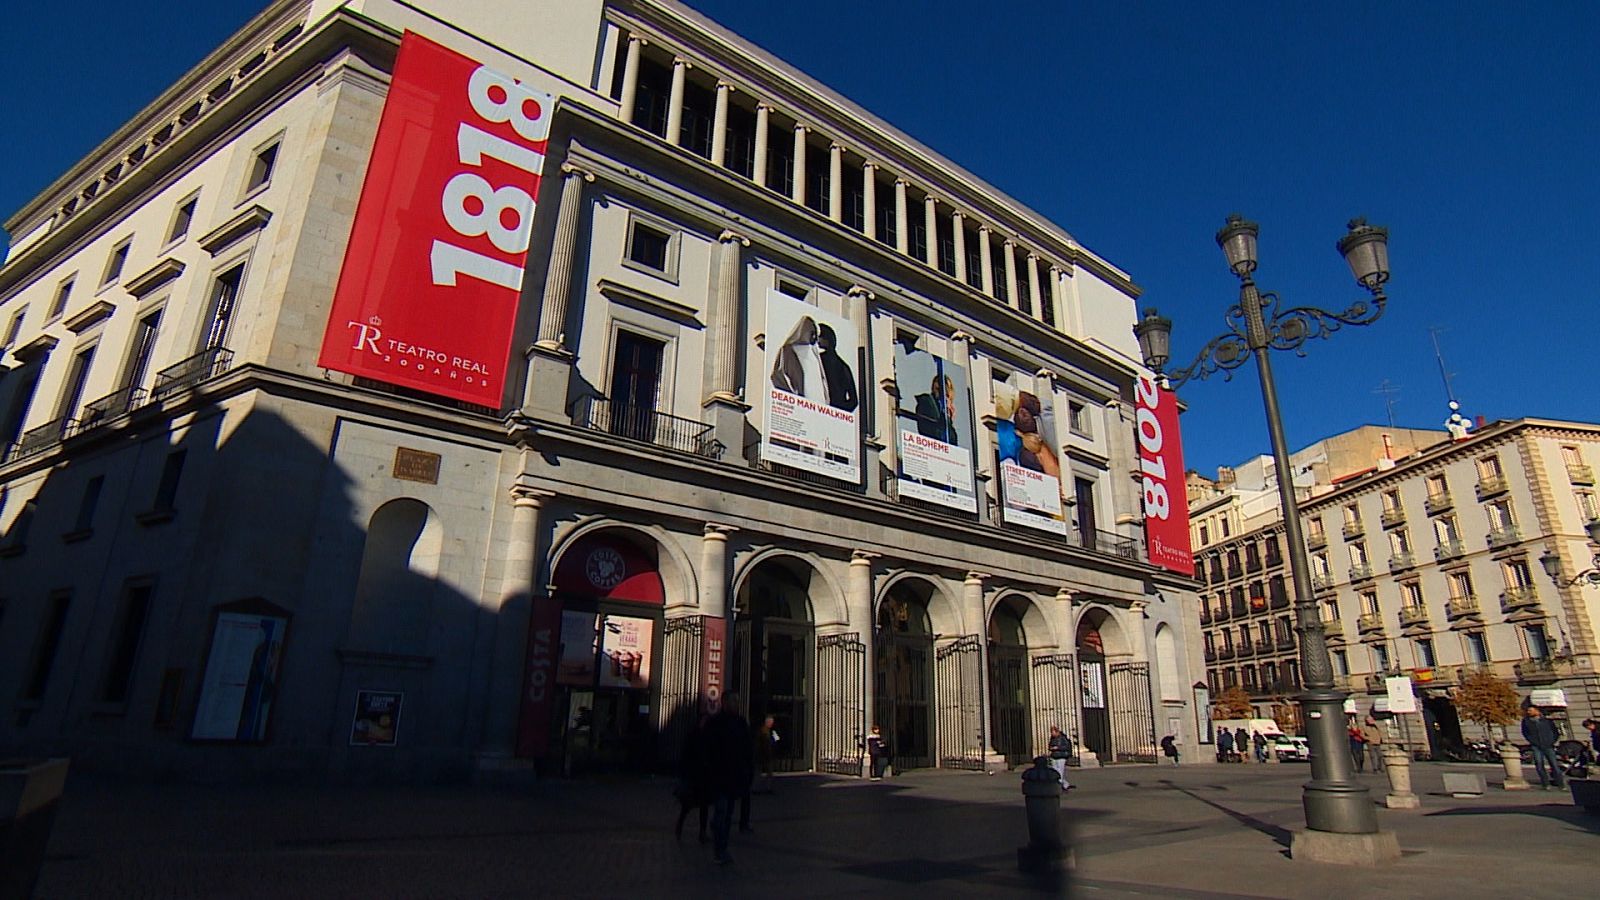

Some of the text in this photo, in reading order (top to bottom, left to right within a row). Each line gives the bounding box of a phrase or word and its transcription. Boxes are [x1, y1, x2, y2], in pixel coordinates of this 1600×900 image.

[430, 64, 556, 292] 1818
[388, 339, 489, 375] TEATRO REAL
[771, 390, 795, 404] DEAD
[796, 398, 816, 411] MAN
[817, 404, 854, 423] WALKING
[903, 432, 915, 443] LA
[1135, 374, 1170, 521] 2018
[1005, 465, 1025, 476] STREET
[1026, 470, 1044, 482] SCENE
[593, 549, 618, 562] COSTA
[590, 571, 620, 586] COFFEE
[529, 628, 551, 702] COSTA
[706, 640, 721, 714] COFFEE
